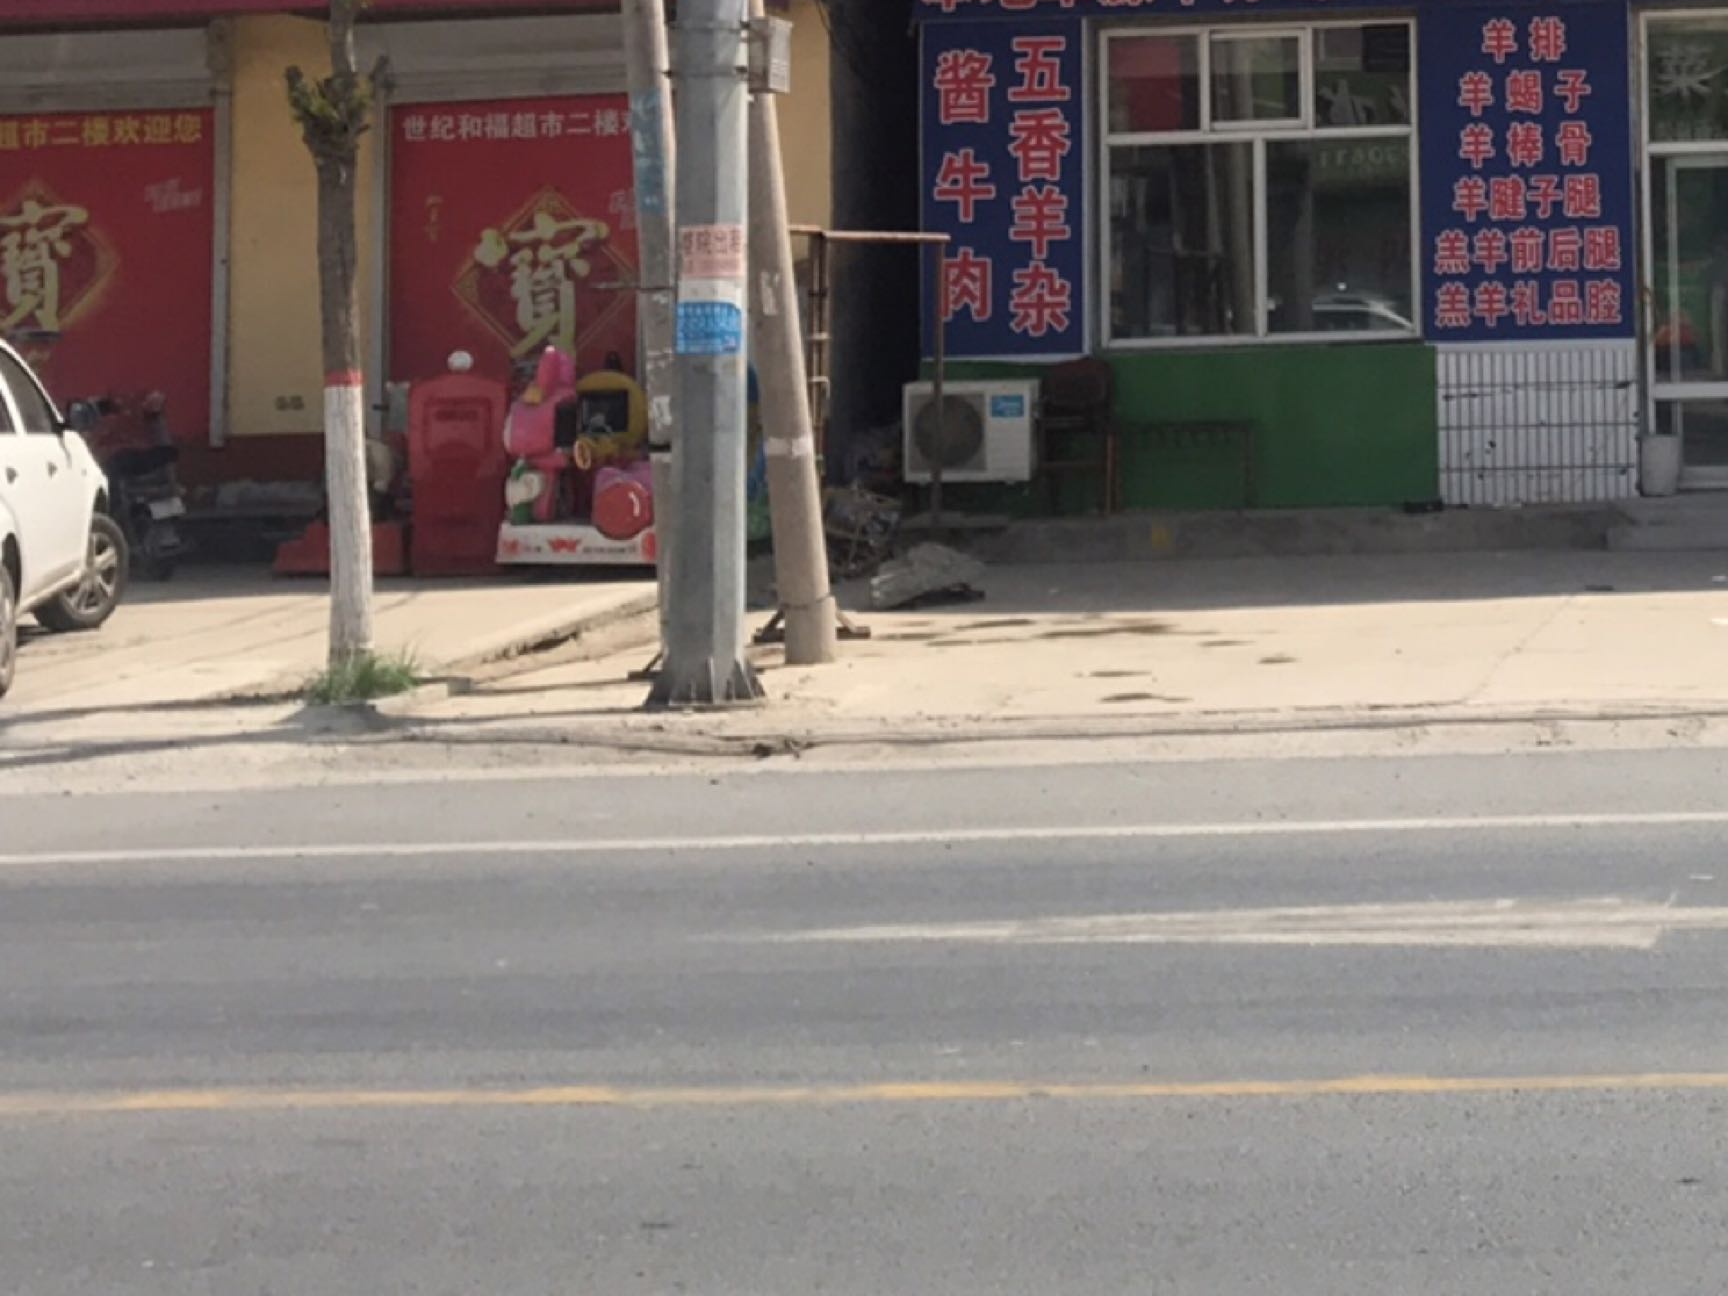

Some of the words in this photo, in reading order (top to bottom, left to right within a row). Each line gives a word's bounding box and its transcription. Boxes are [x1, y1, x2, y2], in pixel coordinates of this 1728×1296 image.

[1481, 16, 1568, 65] 羊排
[1457, 69, 1592, 116] 羊蝎子
[1458, 120, 1592, 169] 羊棒骨
[934, 50, 996, 322] 酱牛肉
[1008, 36, 1071, 337] 五香羊杂
[1433, 224, 1622, 275] 羔羊前后腿
